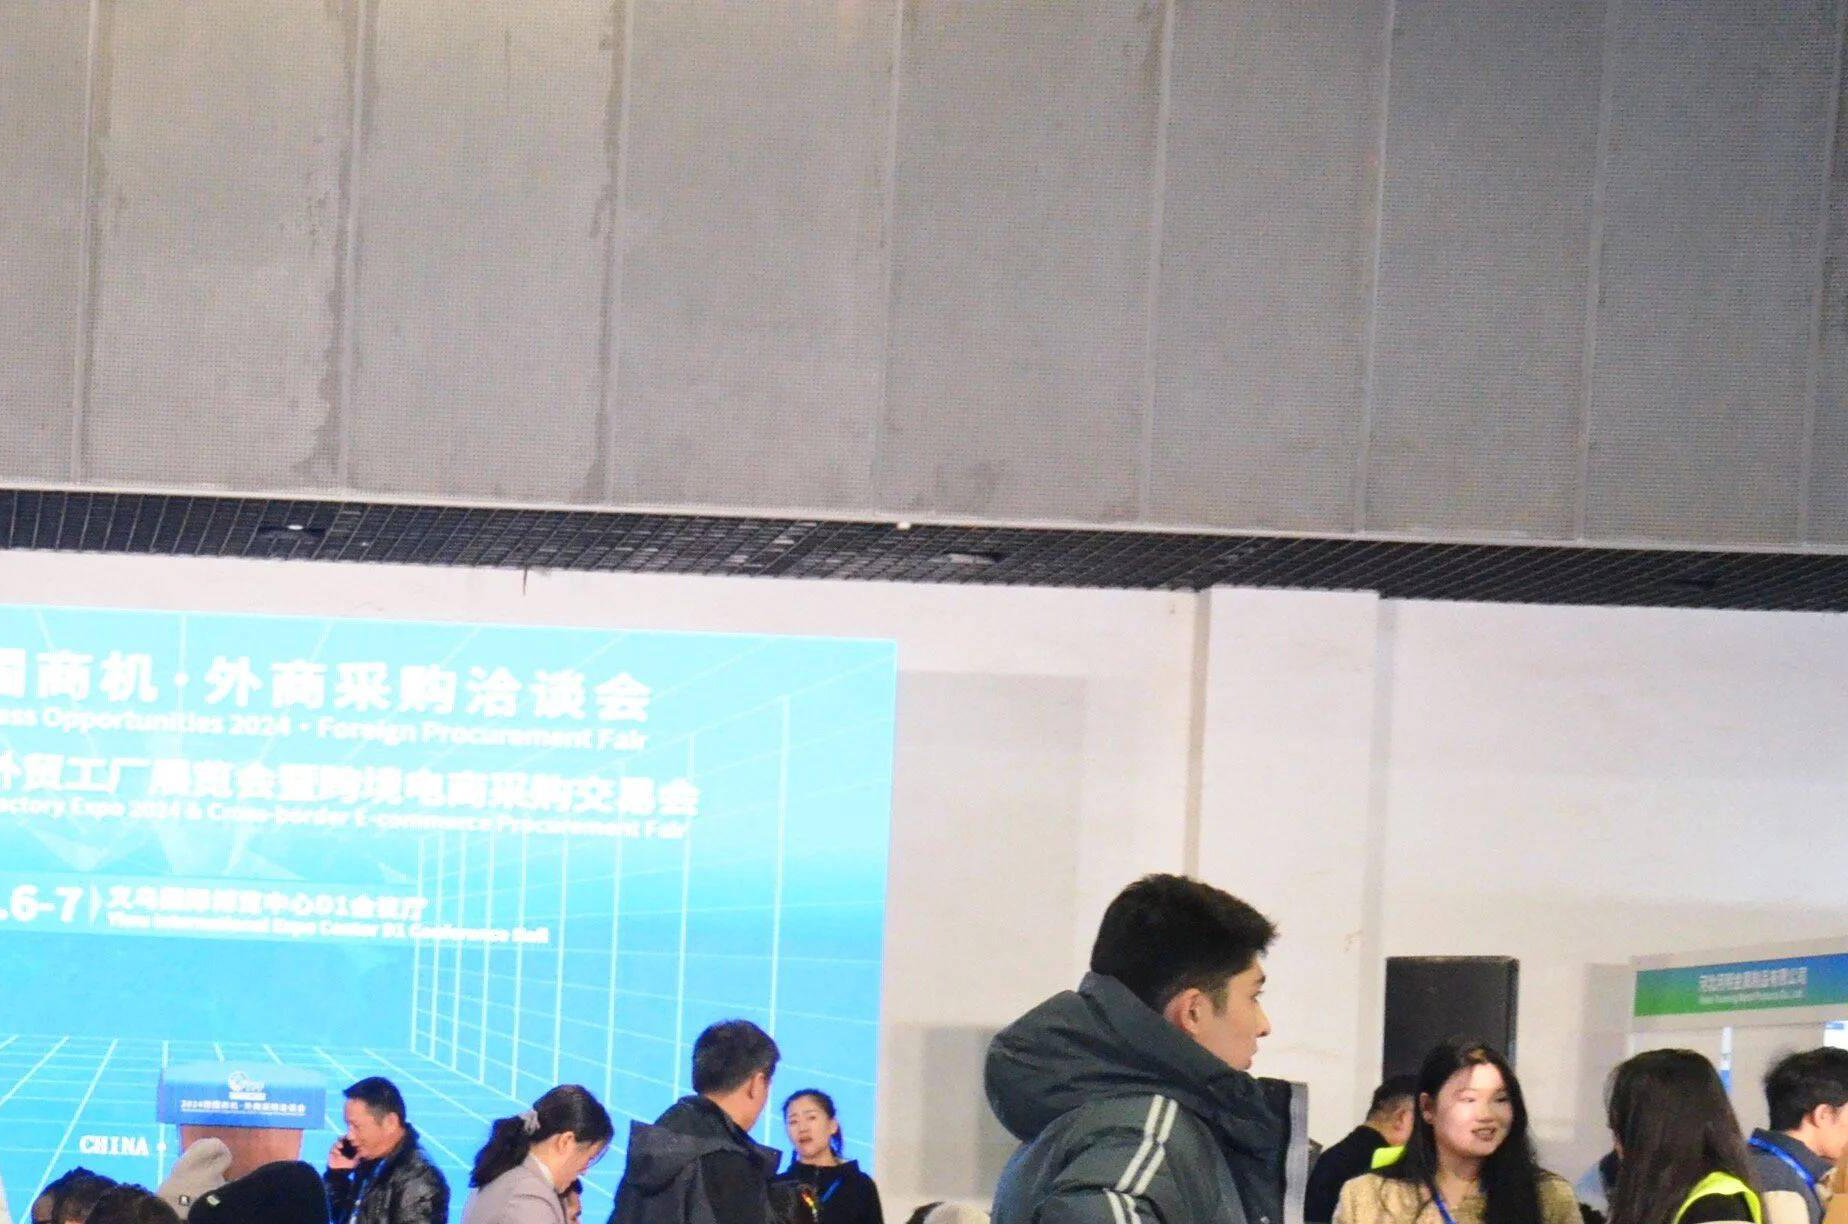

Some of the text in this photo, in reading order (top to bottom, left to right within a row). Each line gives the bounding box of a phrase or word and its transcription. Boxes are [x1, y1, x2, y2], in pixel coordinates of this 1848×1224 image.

[45, 706, 223, 736] Opportunities
[229, 713, 289, 737] 2024
[317, 716, 416, 745] Foreign
[422, 722, 593, 749] Procurement
[599, 728, 647, 751] Fair
[70, 797, 124, 820] Expo
[207, 803, 350, 828] Cross-border
[354, 808, 493, 831] E-commerce
[497, 813, 639, 837] Procurement
[645, 818, 688, 839] Fair
[79, 1135, 149, 1156] CHINA
